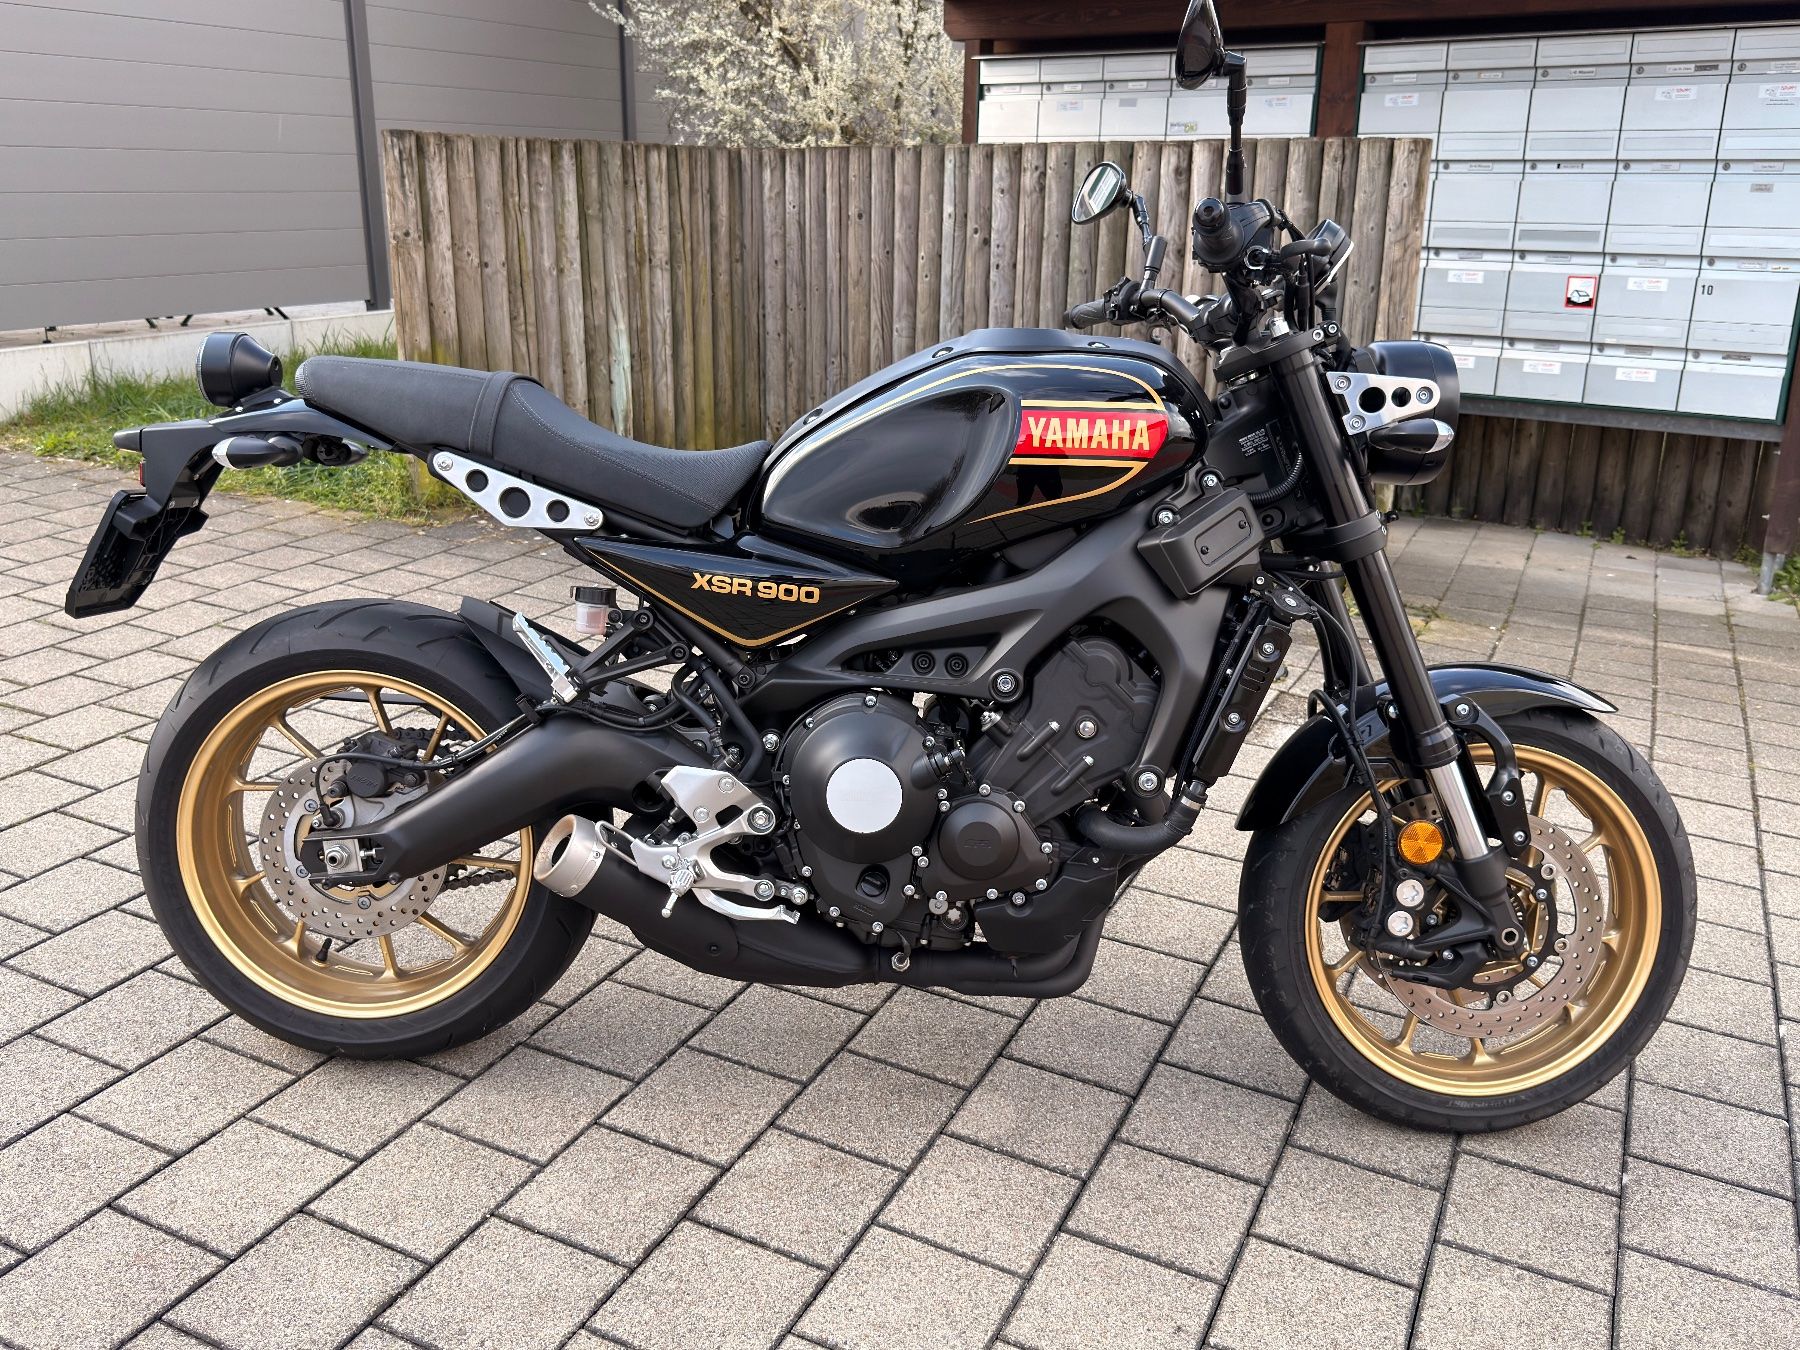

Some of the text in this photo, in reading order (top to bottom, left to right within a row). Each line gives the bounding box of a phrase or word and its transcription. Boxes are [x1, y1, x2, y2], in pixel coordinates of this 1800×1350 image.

[1701, 284, 1714, 296] 10
[1027, 416, 1150, 451] YAMAHA
[690, 571, 820, 604] XSR 900
